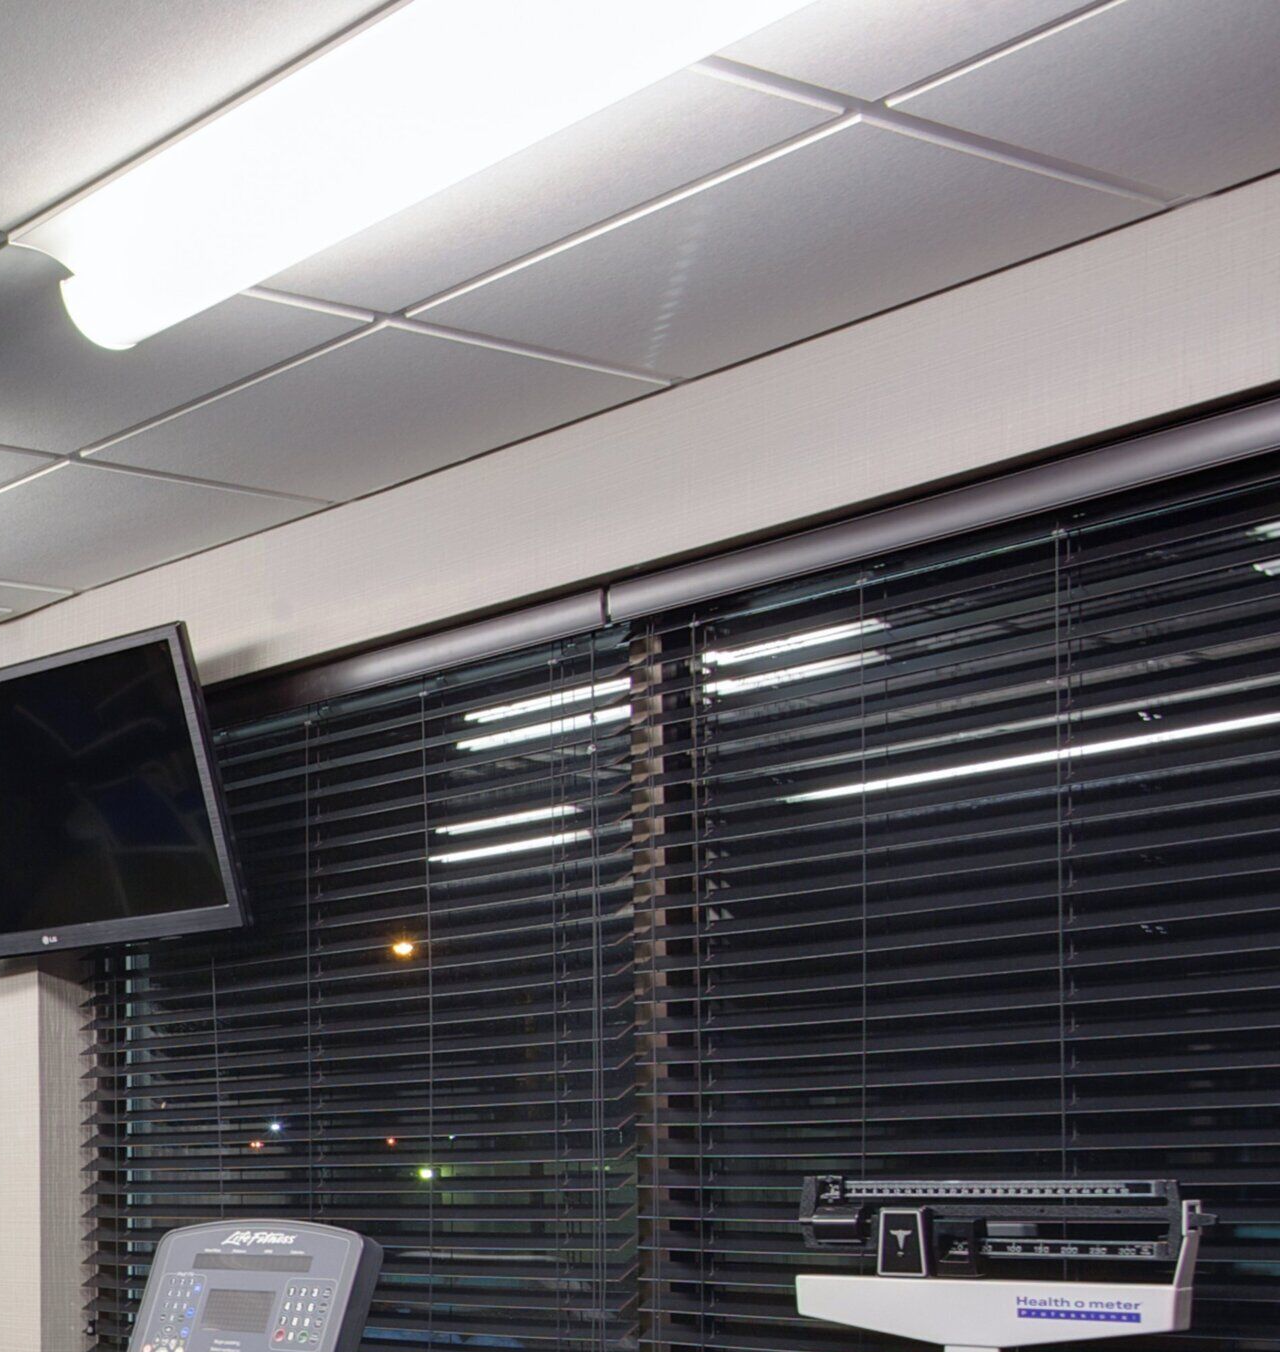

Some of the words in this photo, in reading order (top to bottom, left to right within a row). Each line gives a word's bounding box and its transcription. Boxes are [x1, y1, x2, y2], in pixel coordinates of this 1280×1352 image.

[221, 1230, 251, 1246] Life
[247, 1230, 298, 1247] Fitness
[1006, 1245, 1022, 1254] 100
[1033, 1245, 1050, 1254] 150
[1060, 1246, 1079, 1255] 200
[1016, 1296, 1071, 1308] Health
[1089, 1300, 1142, 1311] meter
[1020, 1309, 1137, 1321] Professional
